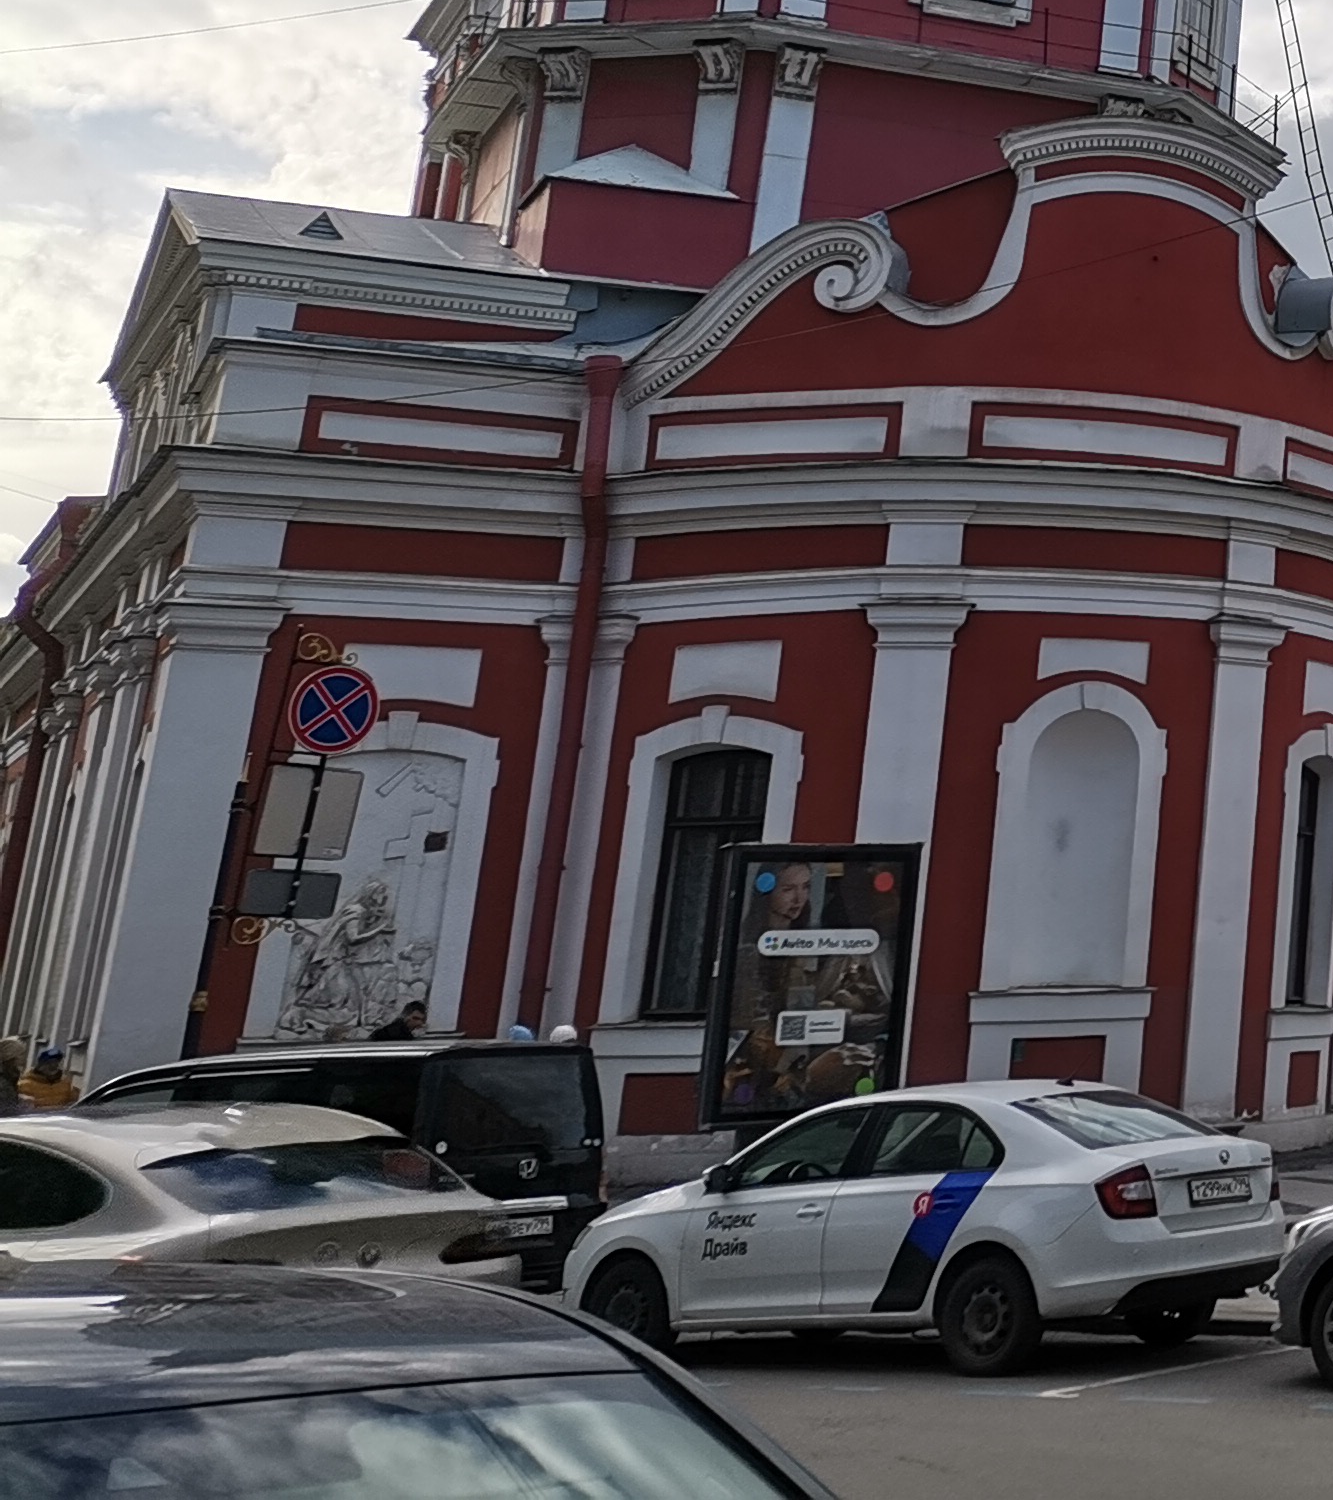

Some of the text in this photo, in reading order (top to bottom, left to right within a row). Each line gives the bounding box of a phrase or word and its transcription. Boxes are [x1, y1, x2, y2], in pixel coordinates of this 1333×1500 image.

[781, 937, 814, 950] Avito
[705, 1210, 757, 1232] Яндекс
[701, 1237, 749, 1261] Драйв
